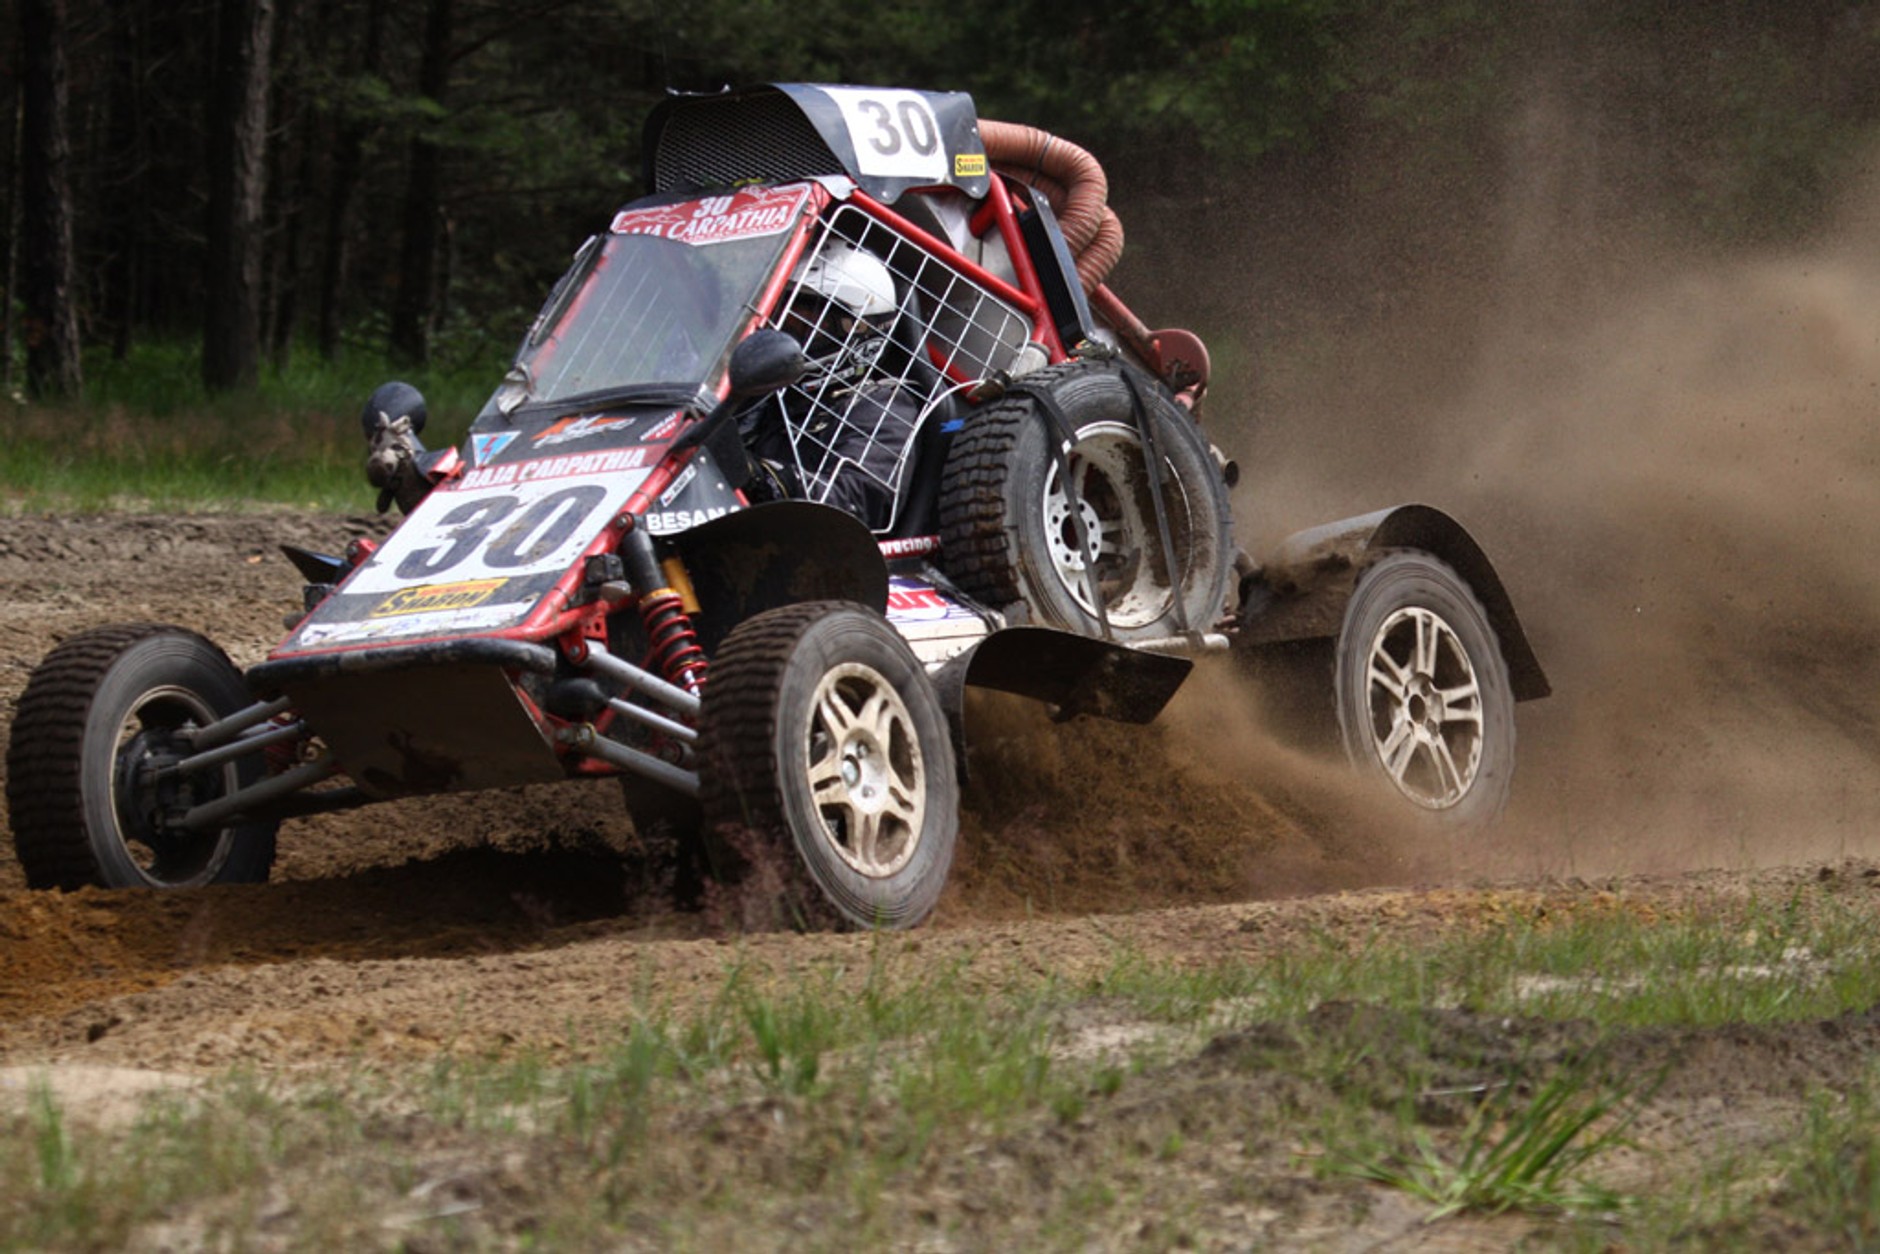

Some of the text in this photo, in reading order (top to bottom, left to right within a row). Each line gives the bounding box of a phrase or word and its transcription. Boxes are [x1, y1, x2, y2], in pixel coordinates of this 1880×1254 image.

[857, 99, 938, 156] 30
[667, 205, 789, 239] CARPATHIA
[694, 196, 735, 218] 30
[462, 448, 645, 488] BAJA CARPATHIA
[394, 485, 607, 579] 30
